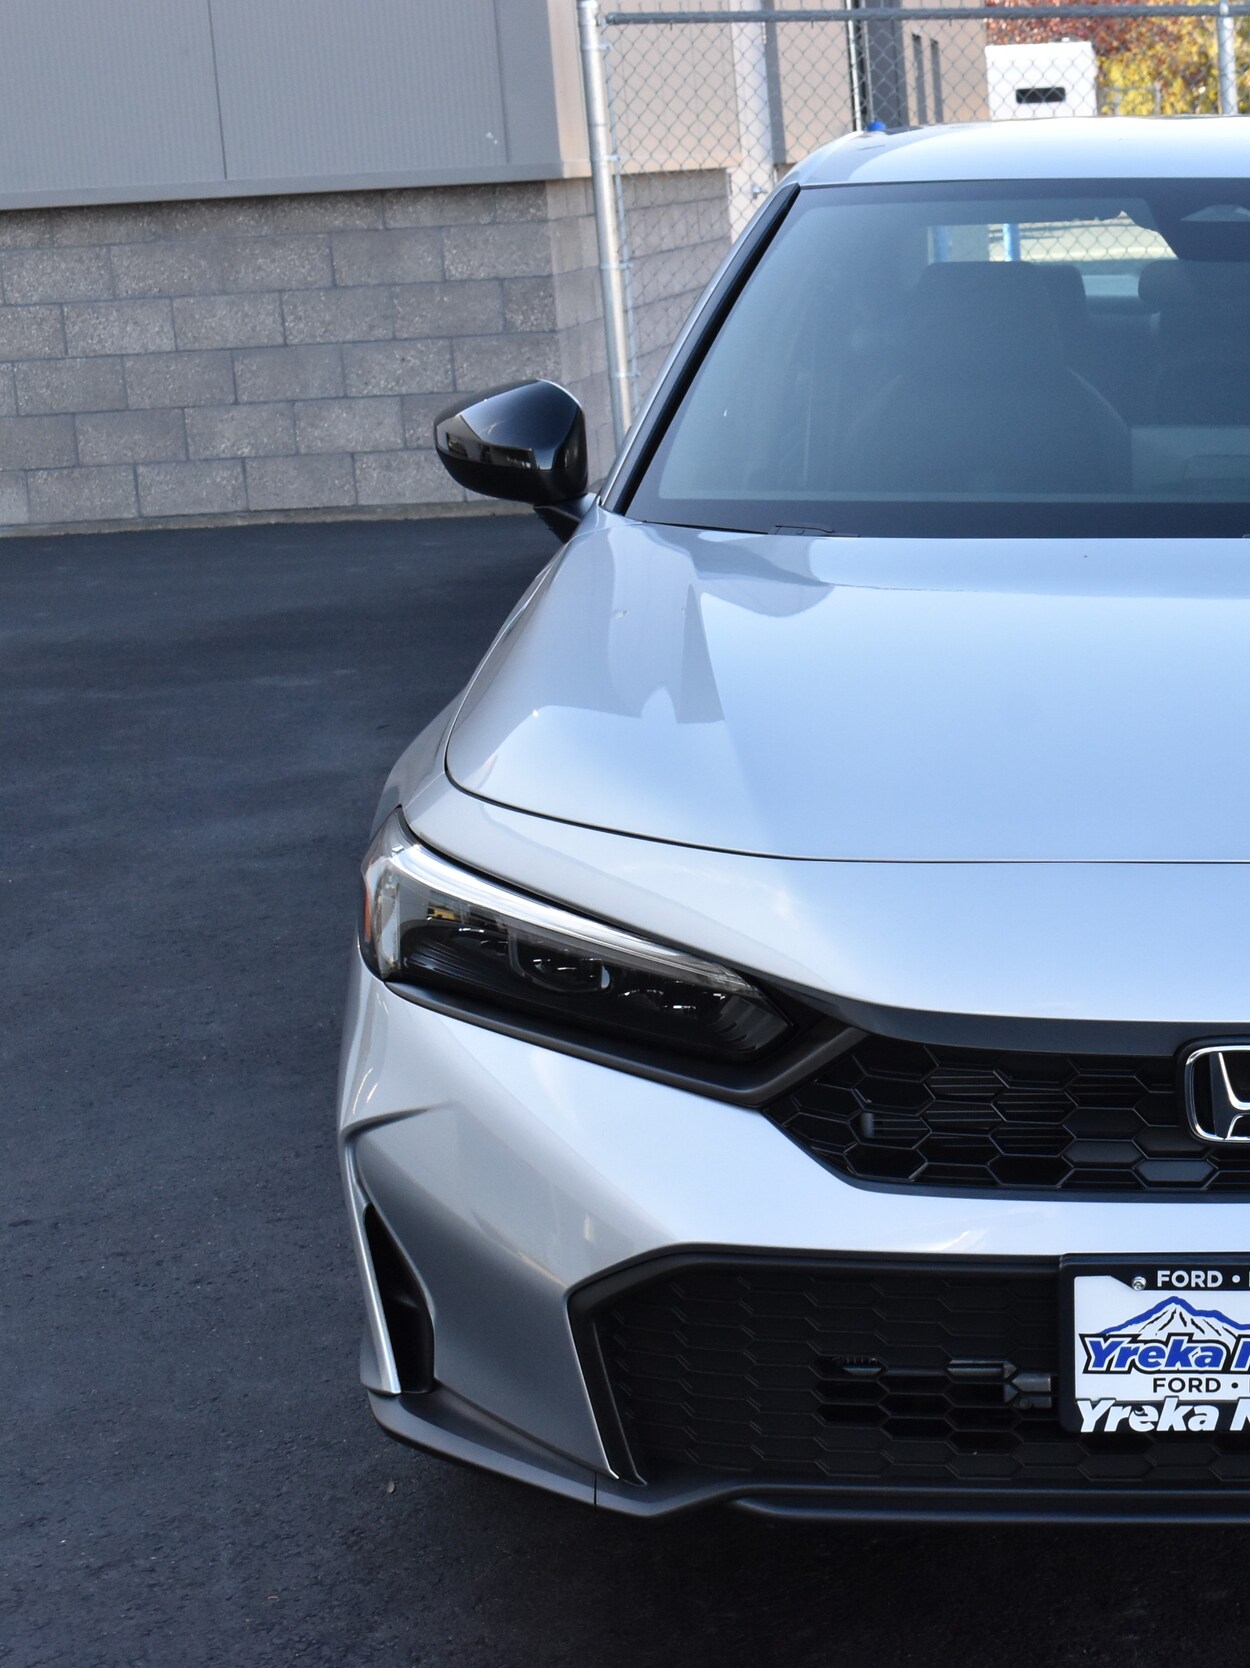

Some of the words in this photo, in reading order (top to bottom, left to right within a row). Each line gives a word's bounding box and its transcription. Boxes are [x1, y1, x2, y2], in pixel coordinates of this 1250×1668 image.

[1157, 1270, 1223, 1288] FORD
[1083, 1335, 1228, 1371] Yreka
[1153, 1377, 1222, 1394] FORD
[1077, 1396, 1219, 1433] Yreka
